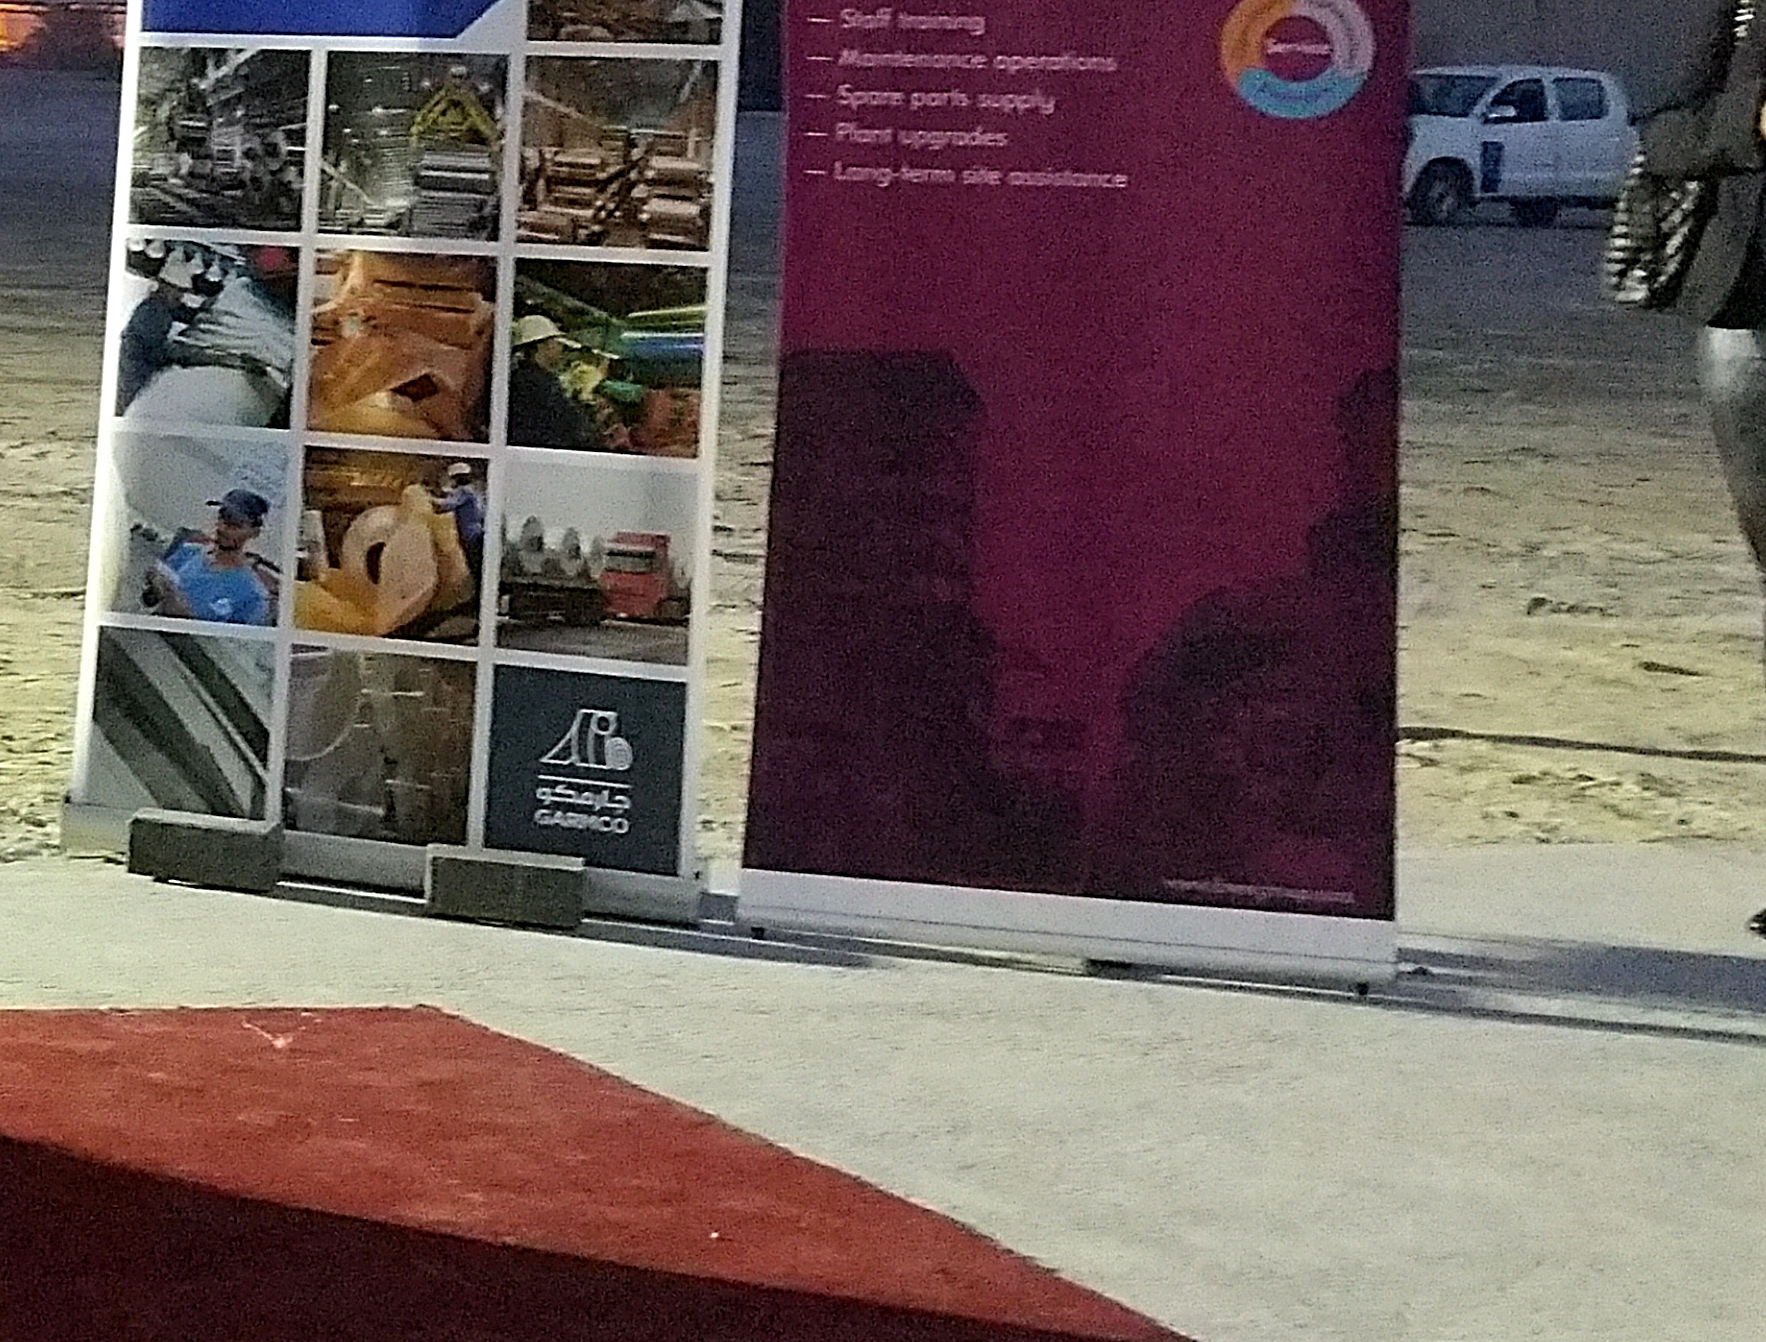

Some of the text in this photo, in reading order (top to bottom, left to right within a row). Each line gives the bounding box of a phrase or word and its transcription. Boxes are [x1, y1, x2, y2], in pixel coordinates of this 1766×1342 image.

[840, 8, 986, 35] Staff training
[838, 49, 1119, 73] Maintenance operations
[837, 84, 1056, 115] Spare parts supply
[835, 122, 1009, 150] Plant upgrades
[833, 161, 1128, 188] Long-term site assistance
[536, 785, 631, 814] جارمكو
[534, 809, 630, 834] GARMCO
